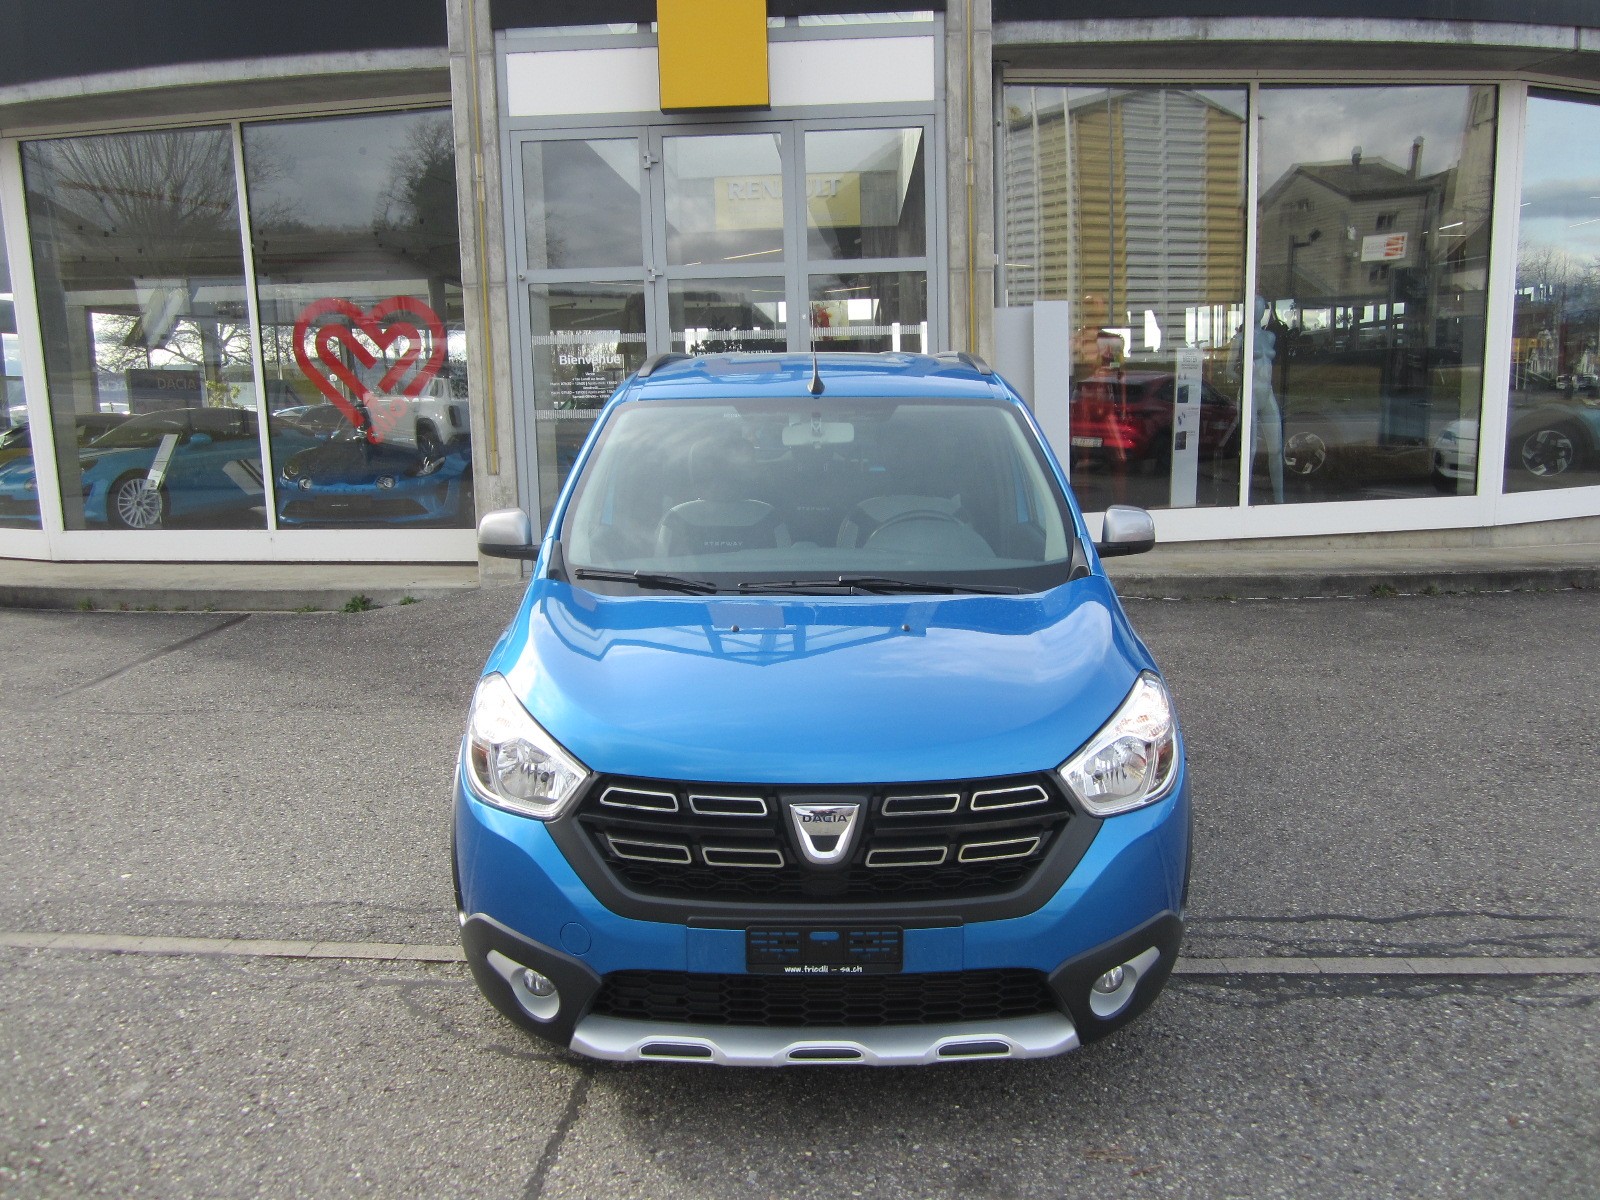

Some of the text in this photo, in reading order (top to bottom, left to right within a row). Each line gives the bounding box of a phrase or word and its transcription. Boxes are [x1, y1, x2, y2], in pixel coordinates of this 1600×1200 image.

[559, 354, 621, 365] Bienvenue
[157, 377, 197, 390] DACIA
[802, 814, 848, 823] DACIA
